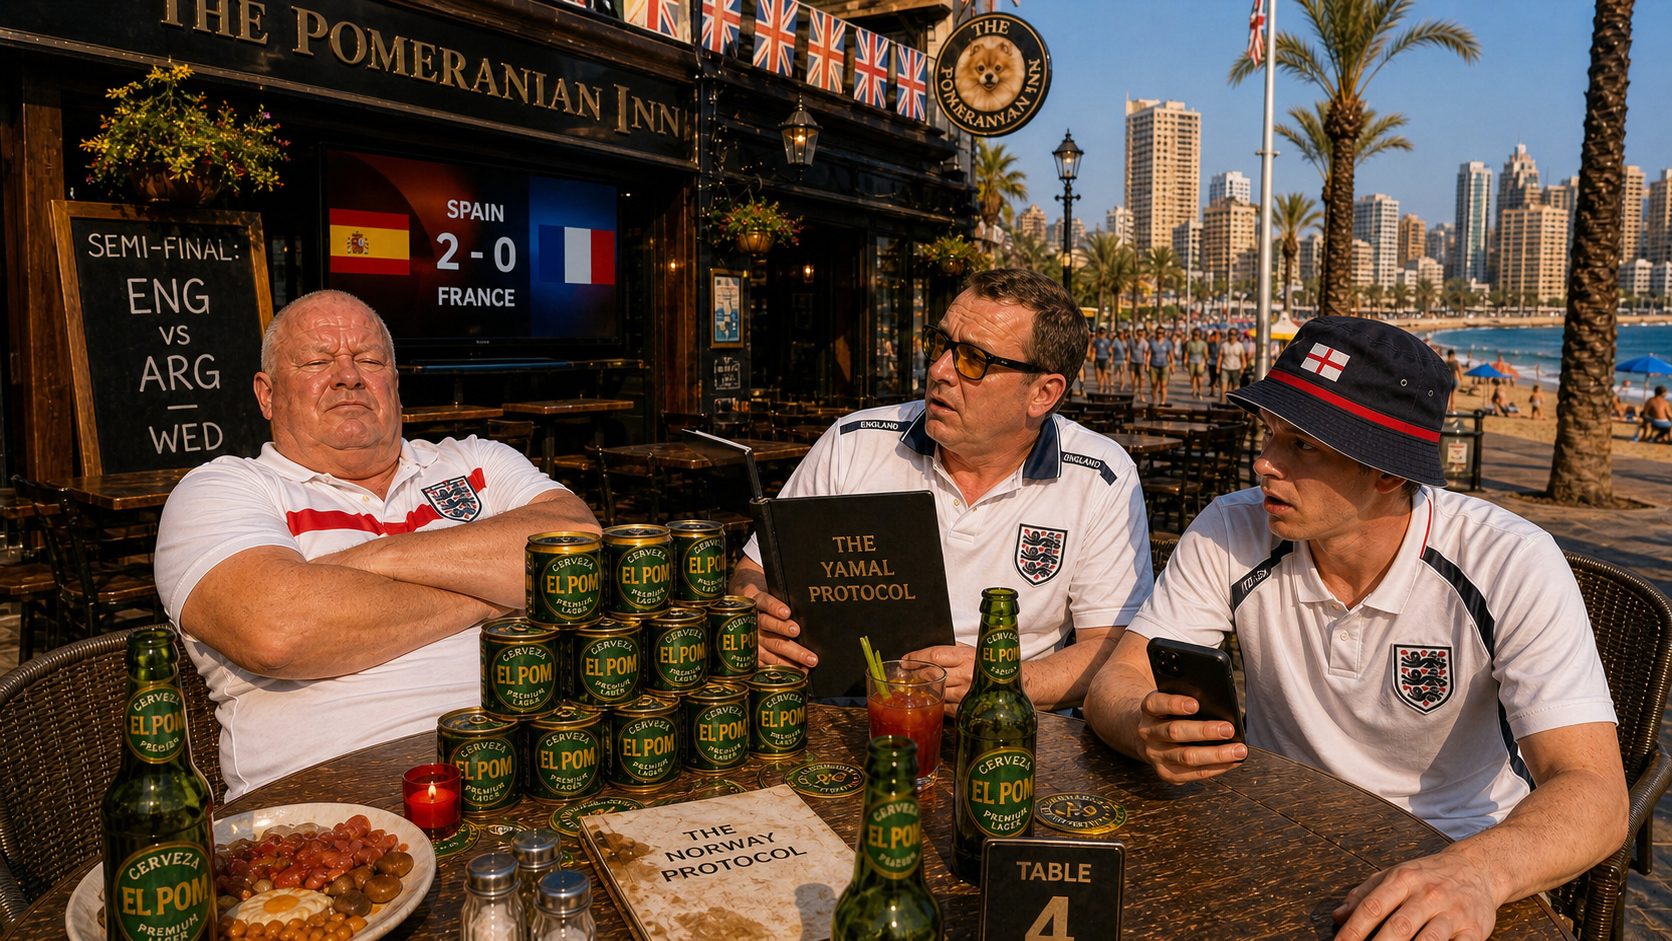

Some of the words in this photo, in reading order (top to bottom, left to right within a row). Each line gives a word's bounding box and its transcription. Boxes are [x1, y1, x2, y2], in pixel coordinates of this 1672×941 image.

[971, 20, 1010, 36] THE
[292, 5, 601, 121] POMERANIAN
[613, 83, 680, 138] INN
[447, 199, 504, 222] SPAIN
[88, 233, 240, 261] SEMI-FINAL:
[436, 232, 459, 270] 2
[494, 236, 516, 273] 0
[127, 278, 210, 315] ENG
[438, 286, 515, 307] FRANCE
[139, 353, 220, 392] ARG
[149, 421, 223, 455] WED
[832, 534, 877, 553] THE
[552, 556, 593, 572] CERVEZA
[622, 566, 639, 584] EL
[642, 563, 670, 584] POM
[689, 556, 704, 574] EL
[820, 559, 895, 578] YAMAL
[547, 576, 565, 594] EL
[568, 572, 598, 594] POM
[808, 583, 916, 603] PROTOCOL
[723, 634, 738, 650] EL
[740, 632, 756, 650] PO
[502, 647, 546, 662] CERVEZA
[660, 646, 678, 664] EL
[680, 642, 704, 664] POM
[984, 648, 996, 662] EL
[496, 665, 515, 685] EL
[518, 662, 552, 685] POM
[586, 658, 603, 676] EL
[606, 654, 636, 676] POM
[130, 716, 150, 735] EL
[762, 710, 778, 727] EL
[780, 706, 805, 727] POM
[546, 732, 590, 747] CERVEZA
[700, 724, 716, 742] EL
[720, 718, 746, 742] POM
[460, 742, 506, 758] CERVEZA
[623, 738, 641, 757] EL
[644, 733, 674, 757] POM
[456, 760, 474, 780] EL
[478, 755, 512, 780] POM
[540, 750, 558, 770] EL
[561, 746, 595, 770] POM
[978, 756, 1030, 774] CERVEZA
[972, 780, 994, 804] EL
[999, 774, 1034, 804] POM
[983, 808, 1028, 822] PREMIUM
[992, 820, 1022, 831] LAGER
[683, 824, 737, 841] THE
[868, 824, 888, 848] EL
[665, 832, 776, 862] NORWAY
[128, 852, 200, 880] CERVEZA
[661, 846, 808, 882] PROTOCOL
[1016, 861, 1092, 883] TABLE
[122, 886, 152, 916] EL
[156, 872, 208, 916] POM
[137, 913, 198, 936] PREMIUM
[1024, 895, 1075, 941] 4
